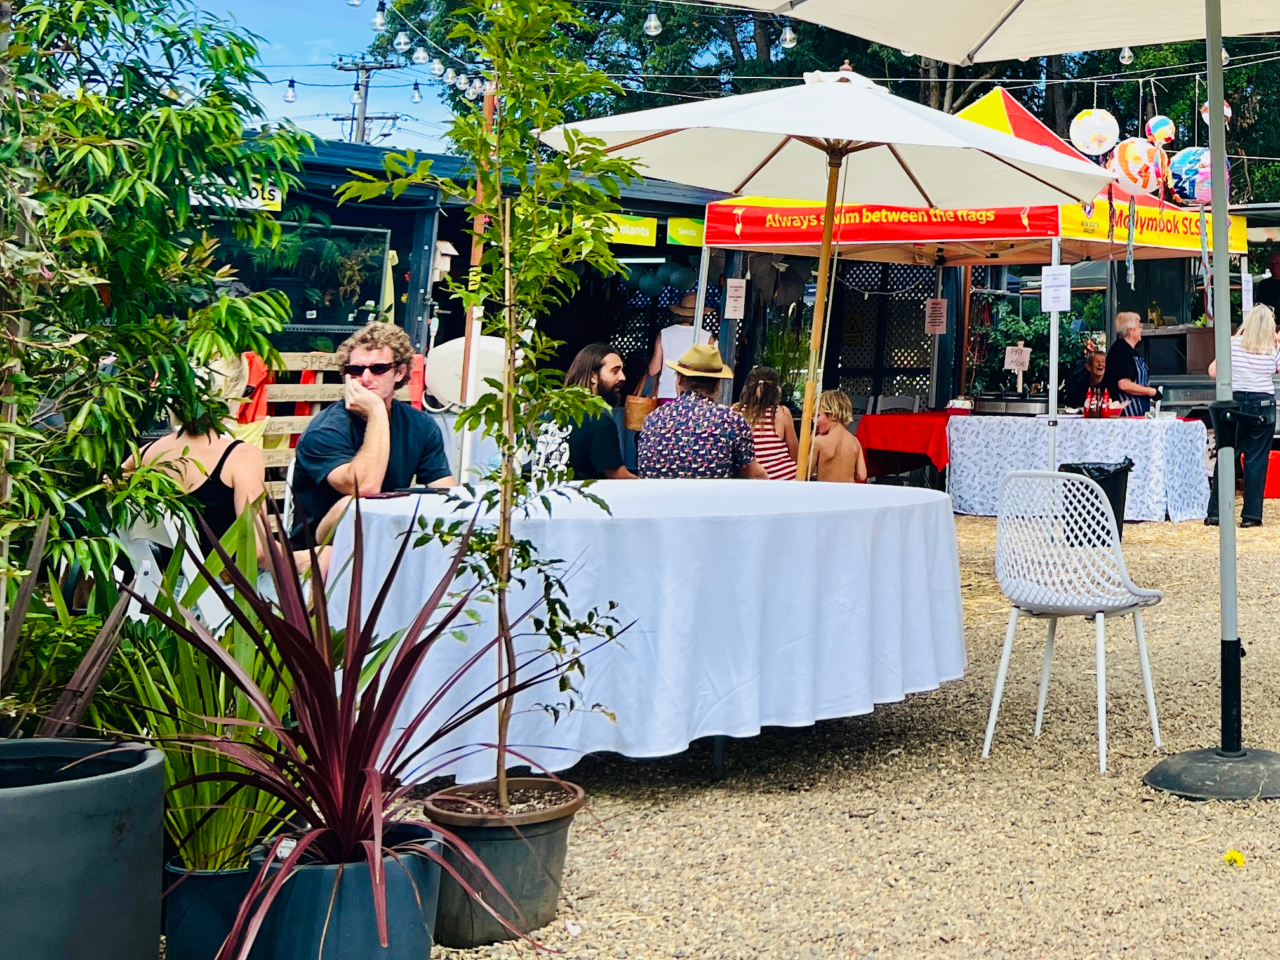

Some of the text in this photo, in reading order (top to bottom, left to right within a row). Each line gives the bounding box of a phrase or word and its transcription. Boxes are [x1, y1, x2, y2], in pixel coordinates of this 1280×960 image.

[765, 213, 818, 230] Always
[862, 208, 928, 223] between
[929, 208, 955, 222] the
[1113, 209, 1180, 235] Molymook
[677, 227, 697, 236] Seeds
